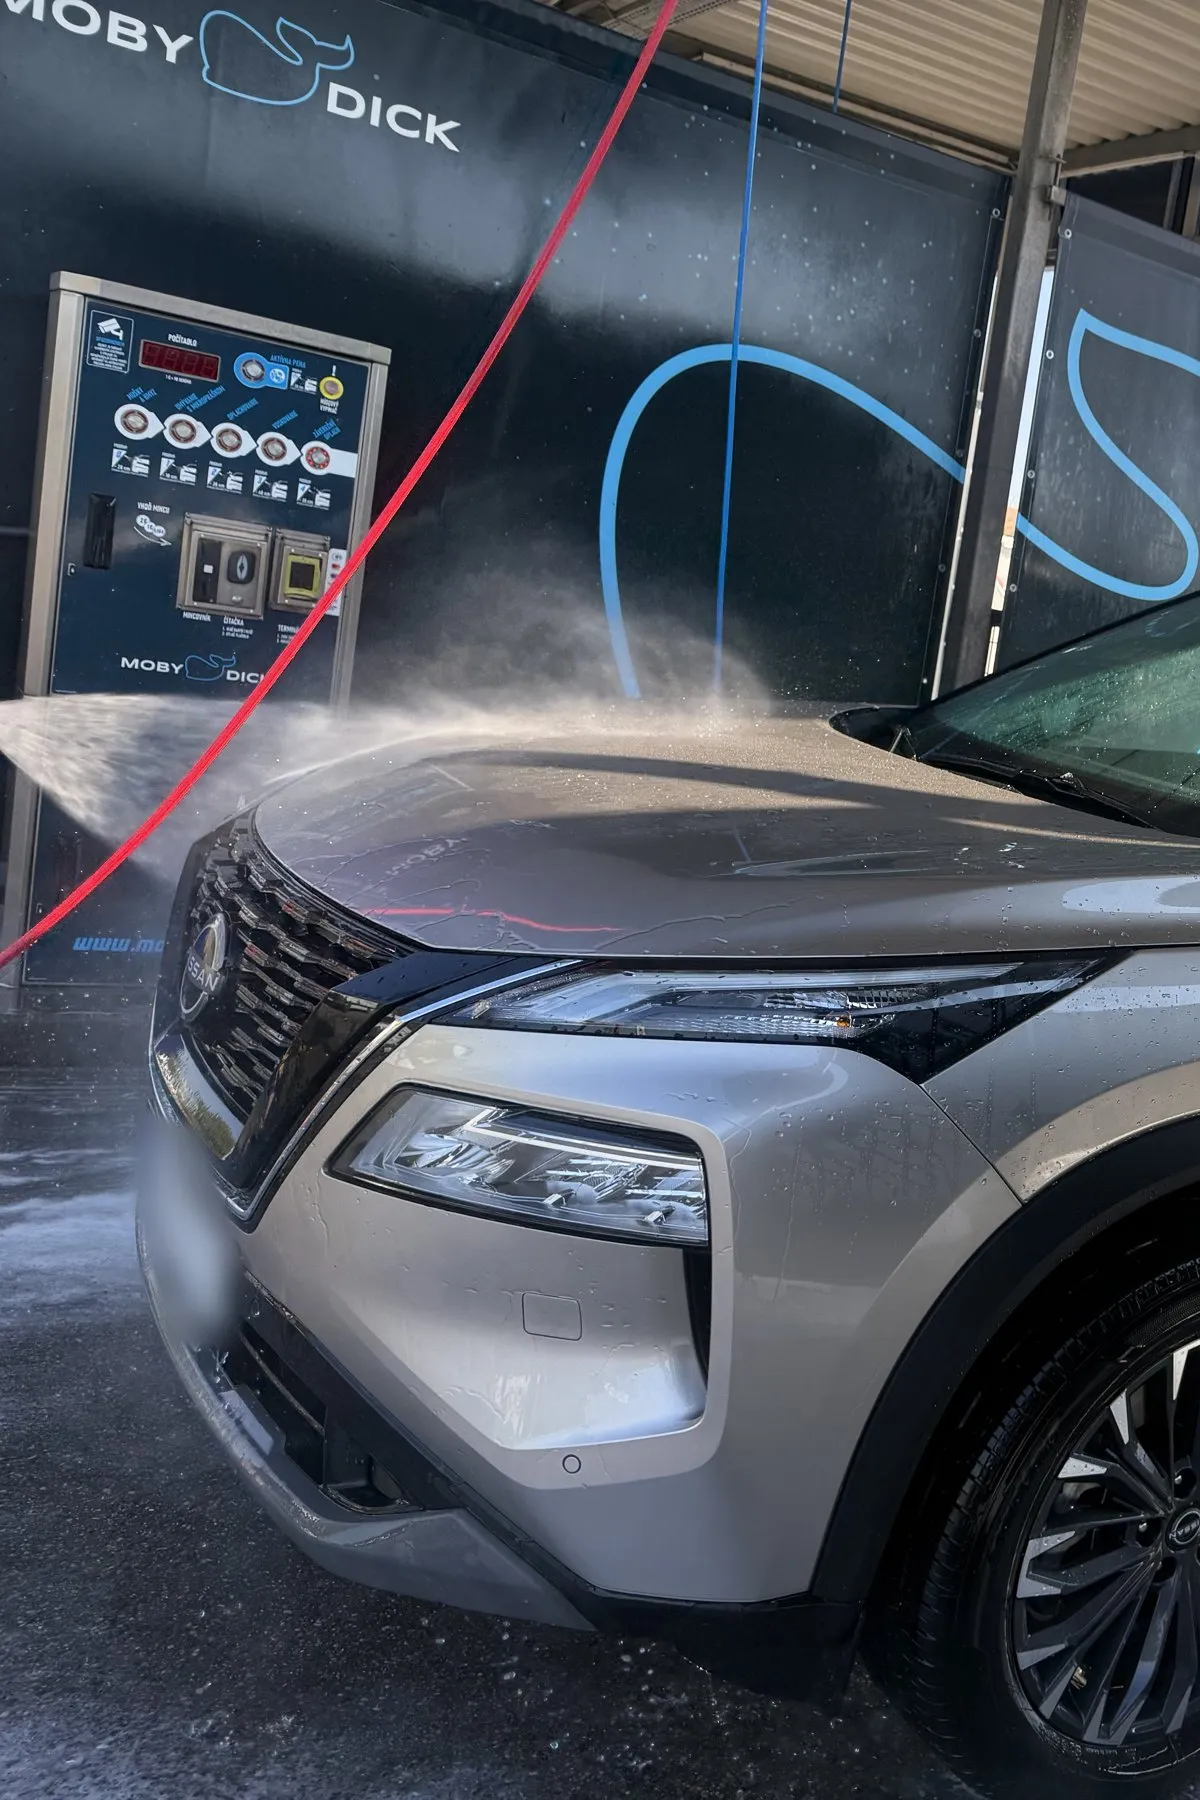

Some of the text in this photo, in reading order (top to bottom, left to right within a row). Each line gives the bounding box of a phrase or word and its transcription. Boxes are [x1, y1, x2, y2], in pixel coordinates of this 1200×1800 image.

[326, 81, 462, 153] DICK
[120, 657, 265, 685] MOBY DIC
[187, 955, 221, 992] SSAN
